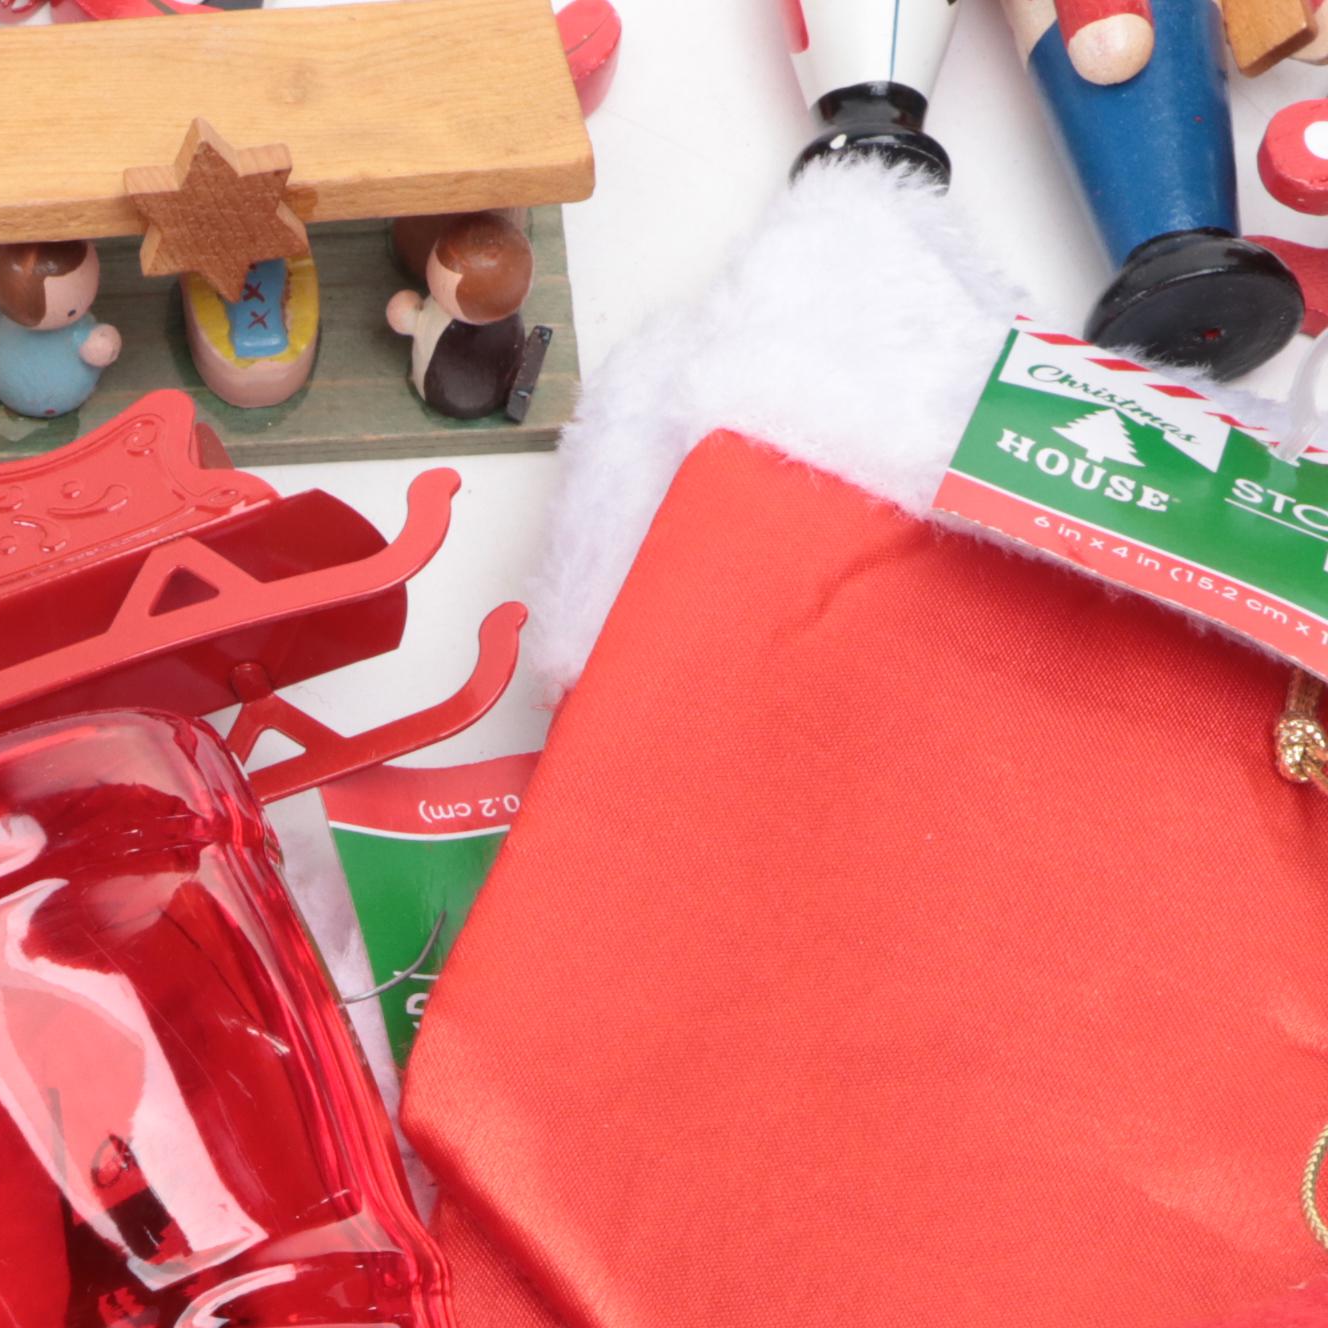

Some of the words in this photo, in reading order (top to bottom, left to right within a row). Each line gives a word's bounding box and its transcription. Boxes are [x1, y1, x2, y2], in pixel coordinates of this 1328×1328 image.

[1027, 364, 1201, 444] Christmas
[996, 428, 1170, 512] HOUSE
[1033, 516, 1051, 528] 6
[1058, 523, 1081, 541] in
[1089, 537, 1105, 549] x
[1112, 547, 1129, 559] 4
[1136, 553, 1161, 571] in
[1169, 567, 1239, 600] (15.2
[1246, 598, 1288, 625] cm
[1295, 621, 1310, 637] x
[418, 800, 472, 824] cm)
